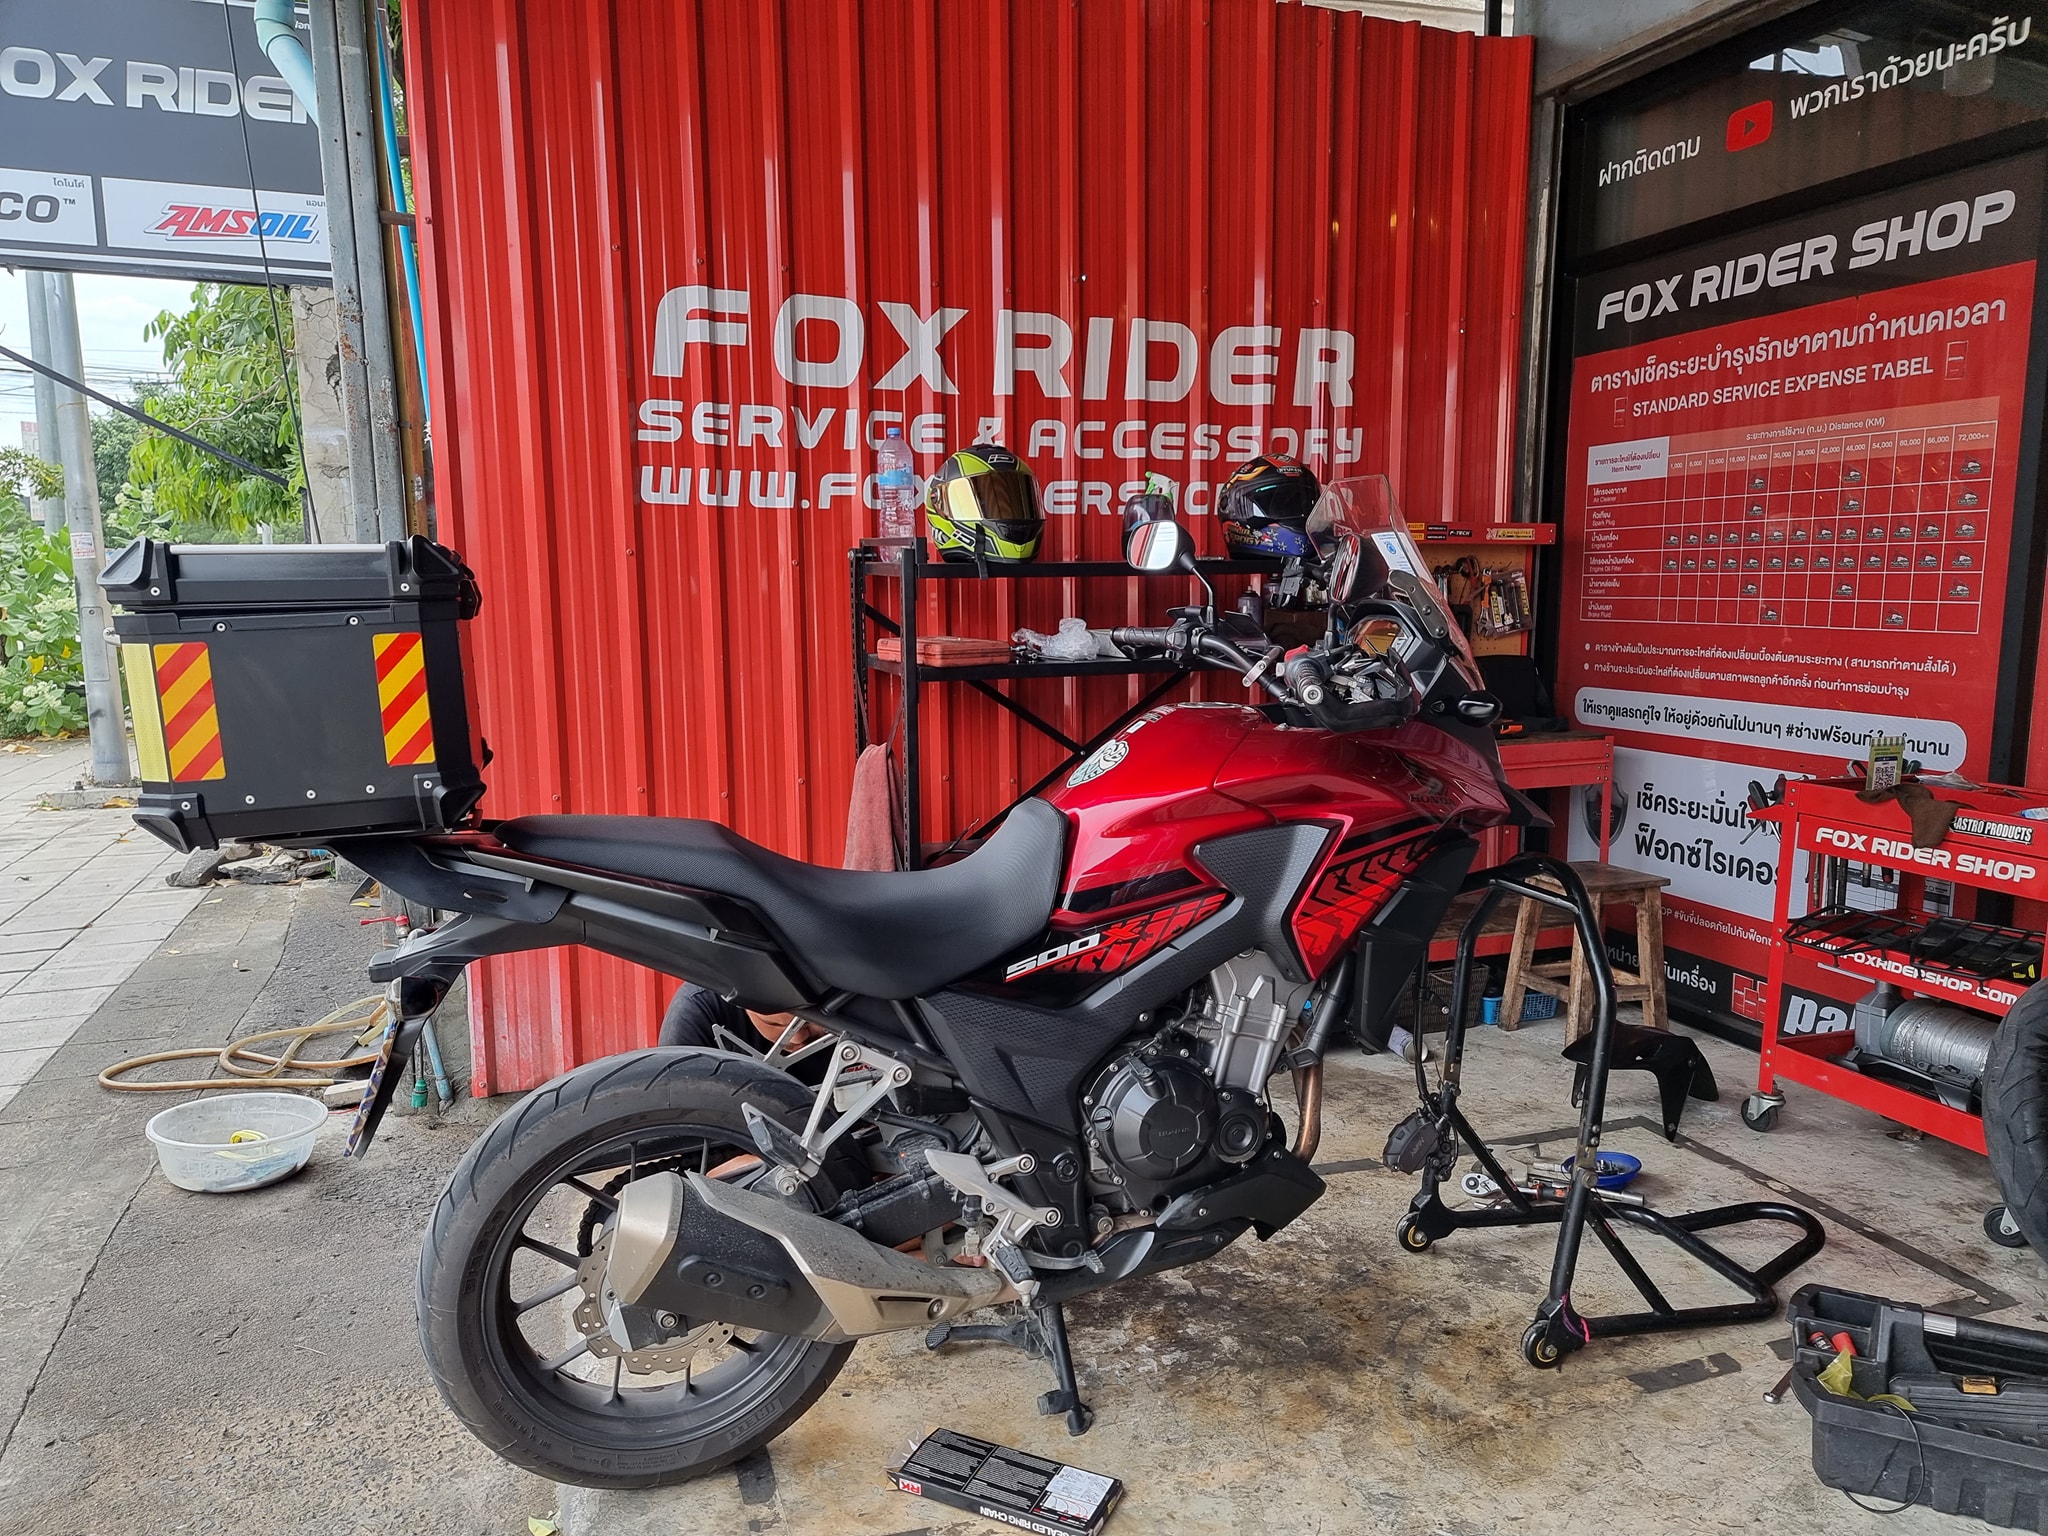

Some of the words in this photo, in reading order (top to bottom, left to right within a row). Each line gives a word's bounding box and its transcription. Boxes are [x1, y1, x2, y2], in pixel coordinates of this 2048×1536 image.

[1599, 135, 1701, 188] ฝากติดตาม
[1790, 15, 2032, 120] พวกเราด้วยนะครับ
[155, 205, 312, 240] AMSOIL
[1597, 274, 1684, 331] FOX
[1690, 234, 1838, 308] RIDER
[1848, 190, 2016, 270] SHOP
[652, 285, 969, 396] FOX
[993, 308, 1356, 410] RIDER
[1591, 299, 2006, 393] ตารางเช็คระยะบำรุงรักษาตามกำหนดเวลา
[1632, 391, 1709, 417] STANDARD
[1713, 379, 1780, 405] SERVICE
[1784, 365, 1867, 394] EXPENSE
[1871, 356, 1934, 380] TABEL
[638, 398, 947, 455] SERVICE
[1028, 418, 1363, 465] ACCESSORY
[1750, 453, 1768, 461] 24,000
[1821, 446, 1840, 454] 42,000
[1872, 441, 1893, 449] 54,000
[1958, 432, 1990, 442] 72,000++
[1829, 418, 1864, 431] Distance
[1865, 417, 1885, 430] (KM)
[1611, 465, 1624, 473] Item
[1625, 463, 1642, 472] Name
[1583, 698, 1661, 726] ให้เราดูแลรถคู่ใจ
[1664, 706, 1782, 739] ให้อยู่ด้วยกันไปนานๆ
[1634, 823, 1778, 887] ฟ็อกซ์ไรเดอ
[1815, 827, 1867, 852] FOX
[1871, 838, 1951, 869] RIDER
[1956, 853, 2036, 883] SHOP
[1957, 817, 1983, 834] ASTRO
[1984, 821, 2033, 842] PRODUCTS
[1006, 921, 1140, 980] 500X
[1784, 995, 1855, 1034] pa
[727, 1397, 785, 1446] PIRELLI
[900, 1479, 921, 1495] RK
